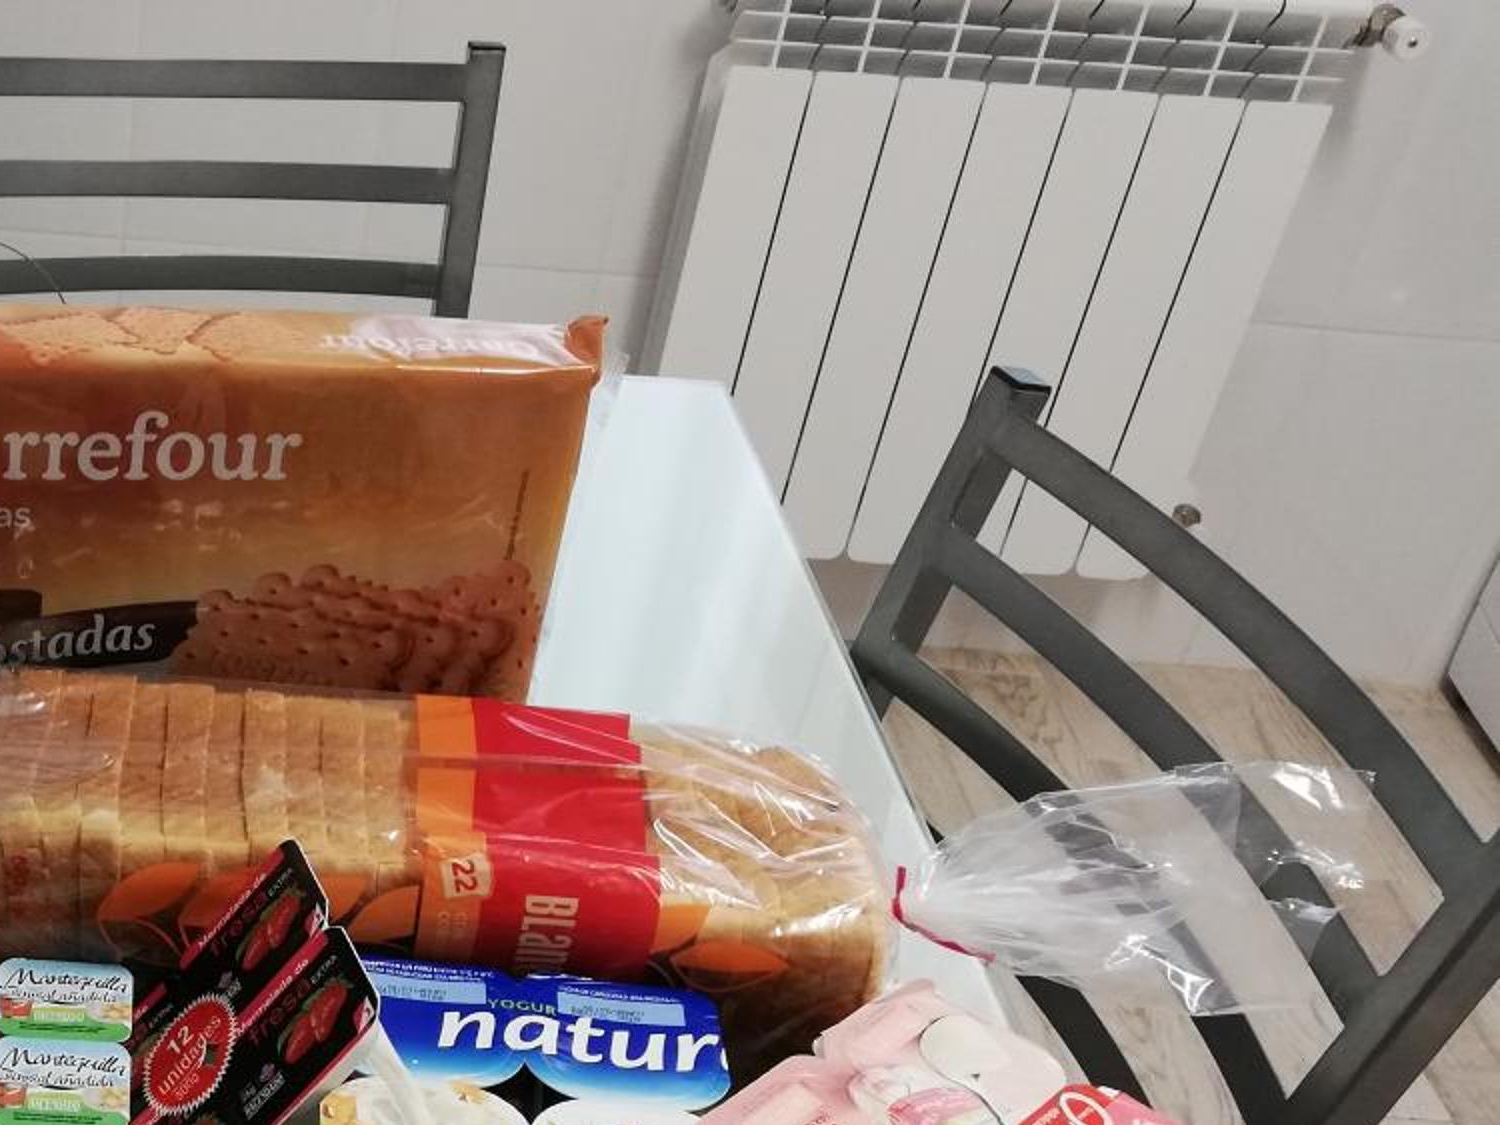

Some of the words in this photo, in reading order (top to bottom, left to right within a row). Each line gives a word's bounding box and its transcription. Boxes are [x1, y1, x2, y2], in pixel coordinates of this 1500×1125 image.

[451, 858, 478, 894] 22
[6, 967, 128, 993] Mantequilla
[310, 954, 339, 985] EXTRA
[486, 997, 558, 1017] YOGUR
[166, 1025, 195, 1054] 12
[438, 1011, 729, 1073] natur
[3, 1047, 127, 1077] Mantequilla
[157, 1015, 221, 1096] unidades
